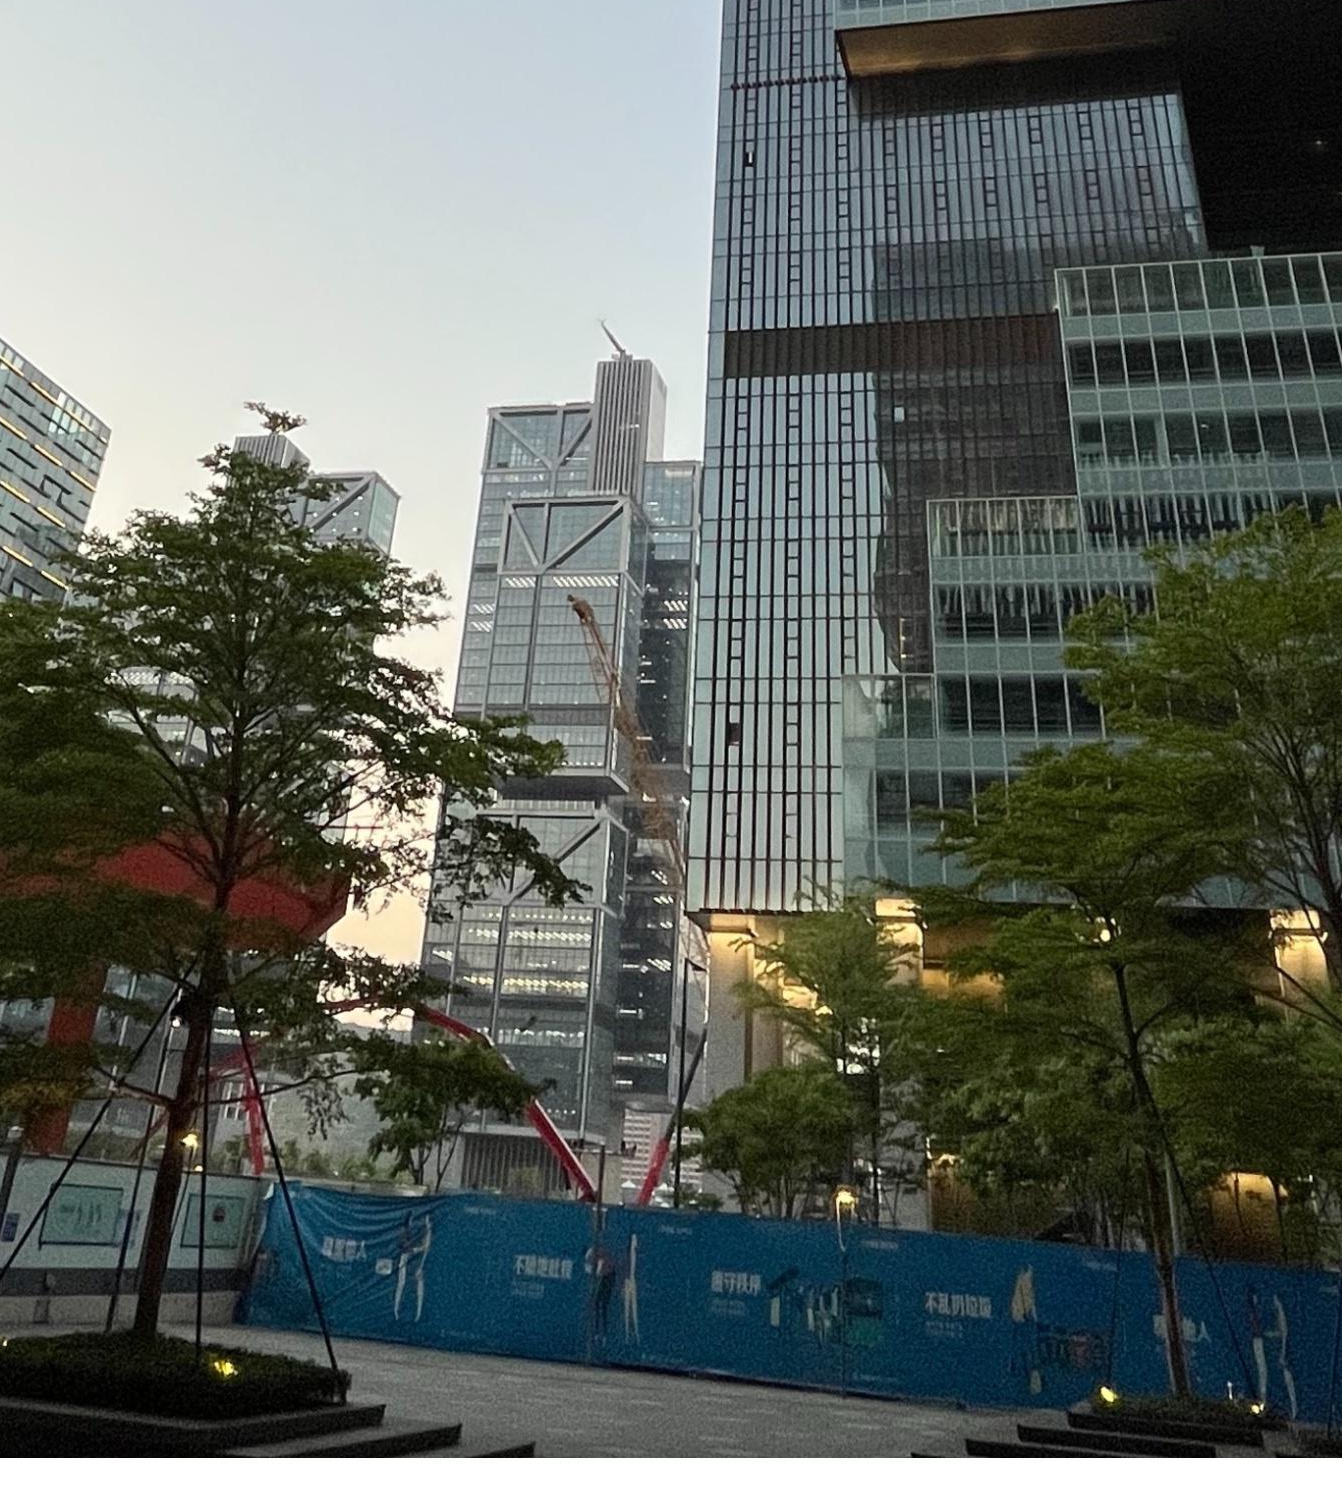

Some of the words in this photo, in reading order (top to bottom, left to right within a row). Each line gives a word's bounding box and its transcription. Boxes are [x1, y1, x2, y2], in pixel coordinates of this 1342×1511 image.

[923, 1291, 993, 1320] 不乱扔垃圾
